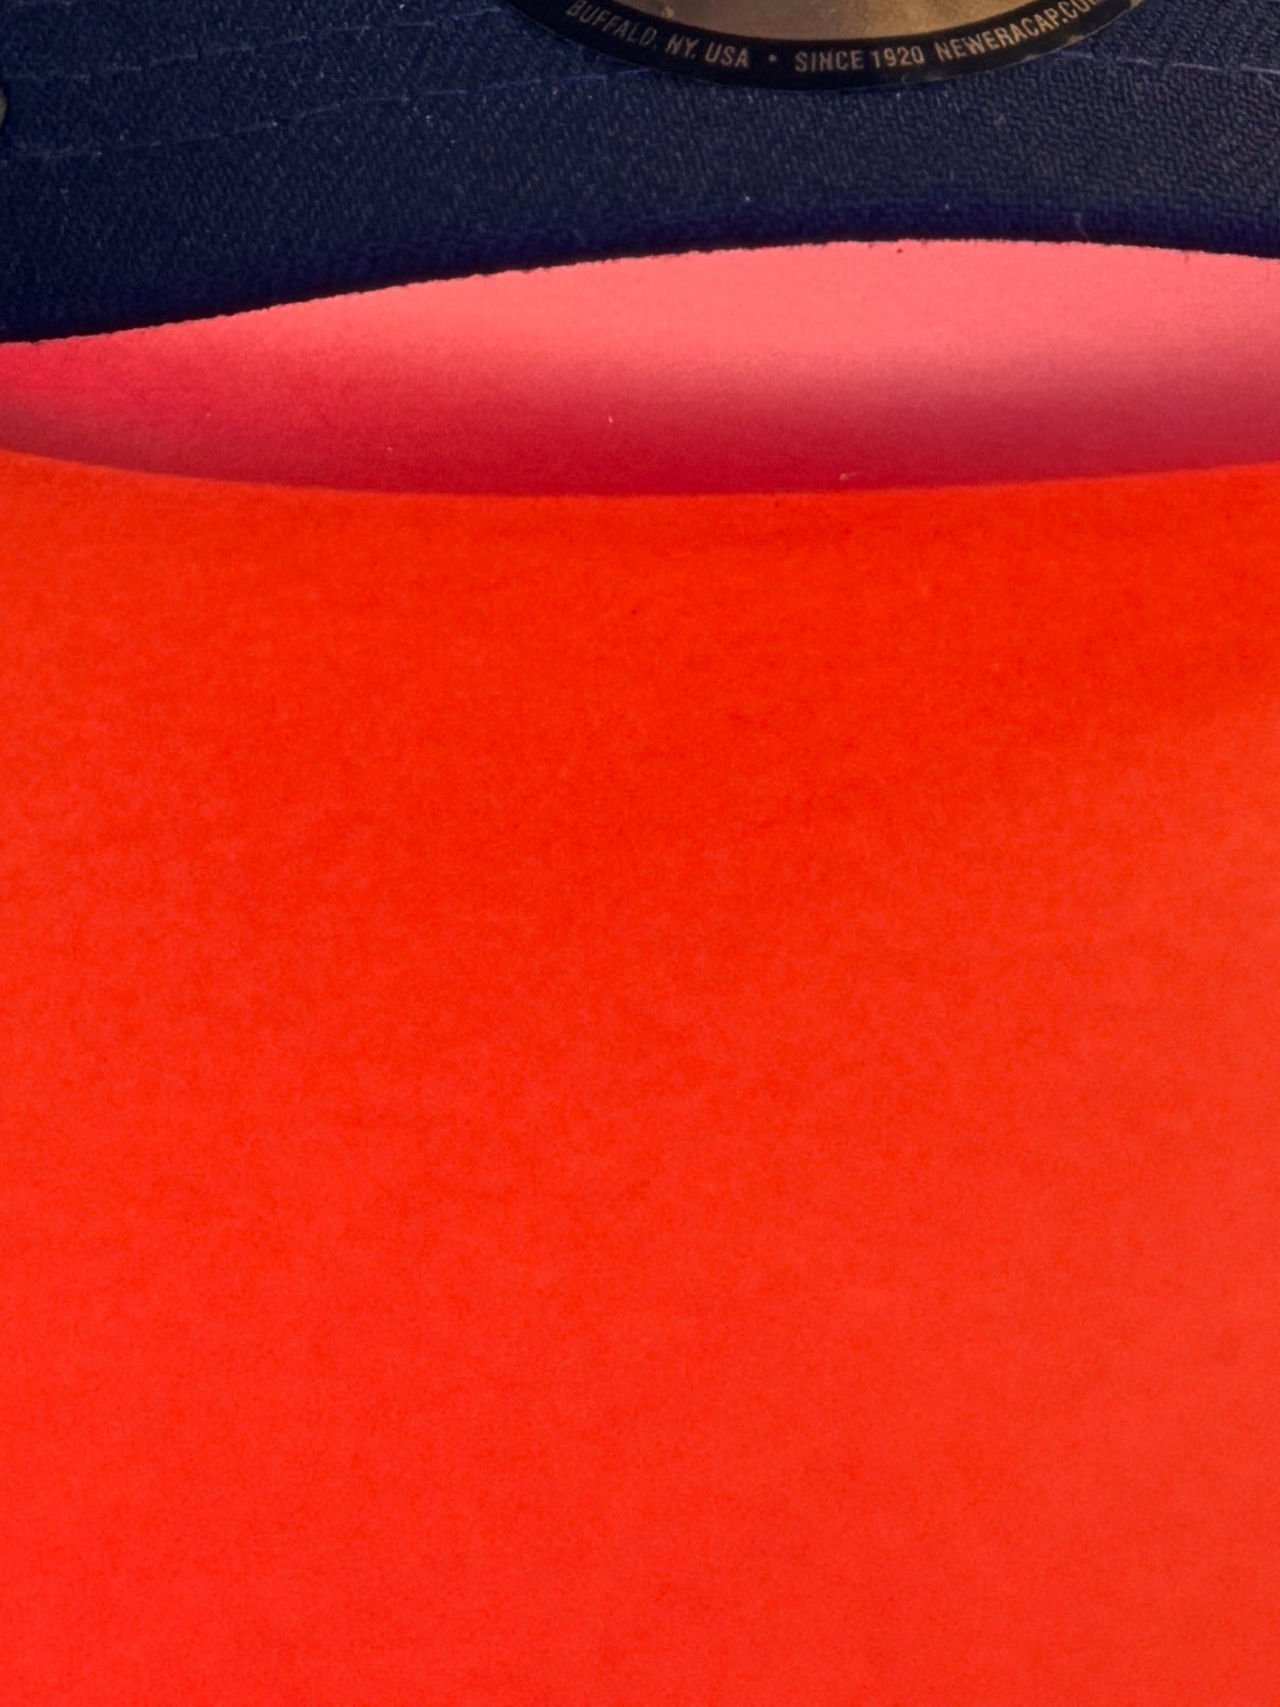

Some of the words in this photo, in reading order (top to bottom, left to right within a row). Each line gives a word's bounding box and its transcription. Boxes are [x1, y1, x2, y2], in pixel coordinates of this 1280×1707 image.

[704, 41, 750, 68] USA
[794, 50, 865, 73] SINCE
[871, 45, 925, 69] 1920
